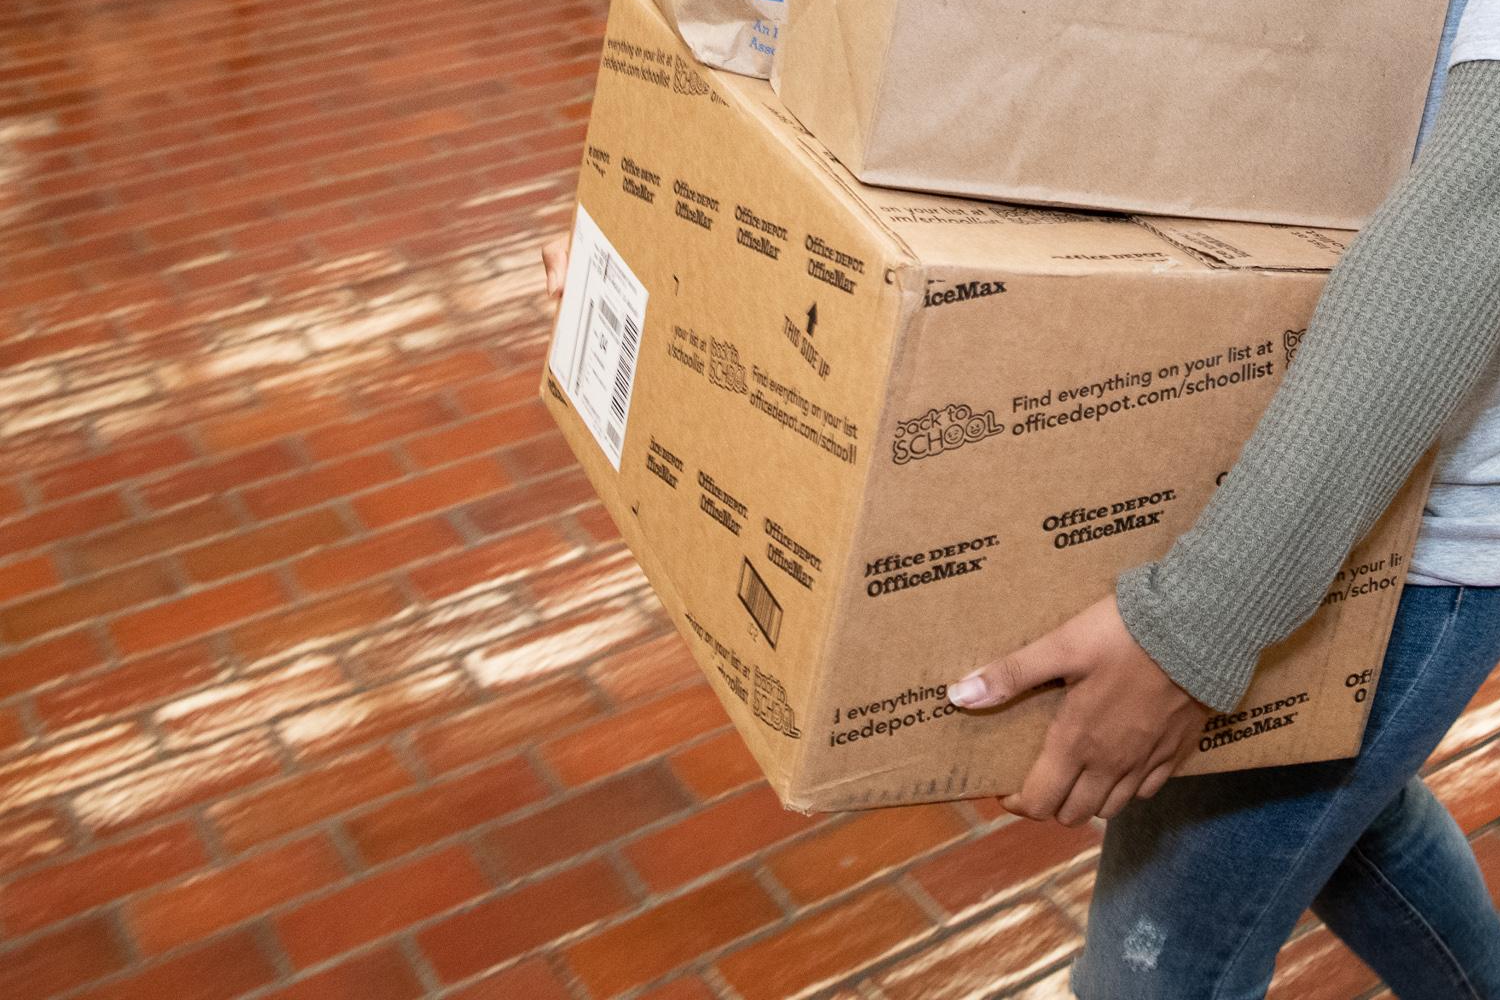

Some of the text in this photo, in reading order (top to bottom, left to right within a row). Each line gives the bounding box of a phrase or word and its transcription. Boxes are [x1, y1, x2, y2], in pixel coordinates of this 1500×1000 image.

[621, 157, 641, 179] Office
[622, 176, 655, 205] OfficeMax
[674, 178, 697, 201] Office
[675, 201, 714, 232] OfficeMax
[735, 205, 762, 229] Office
[736, 227, 782, 261] OfficeMax
[805, 234, 836, 261] Office
[807, 258, 858, 296] OfficeMax
[783, 313, 831, 382] THIS SIDE UP
[1012, 389, 1052, 414] Find
[1057, 370, 1152, 404] everything
[1158, 363, 1180, 380] on
[1184, 354, 1224, 377] your
[1228, 346, 1252, 364] list
[1256, 340, 1274, 357] at
[752, 364, 858, 440] Find everything on your list
[1012, 361, 1275, 436] officedepot.com/schoollist
[895, 412, 1003, 462] SCHOOL
[698, 470, 723, 499] Office
[700, 493, 743, 538] OfficeMax
[1042, 507, 1108, 532] Office
[764, 517, 794, 551] Office
[767, 543, 816, 592] OfficeMax
[1349, 560, 1386, 582] your
[847, 683, 948, 721] everything
